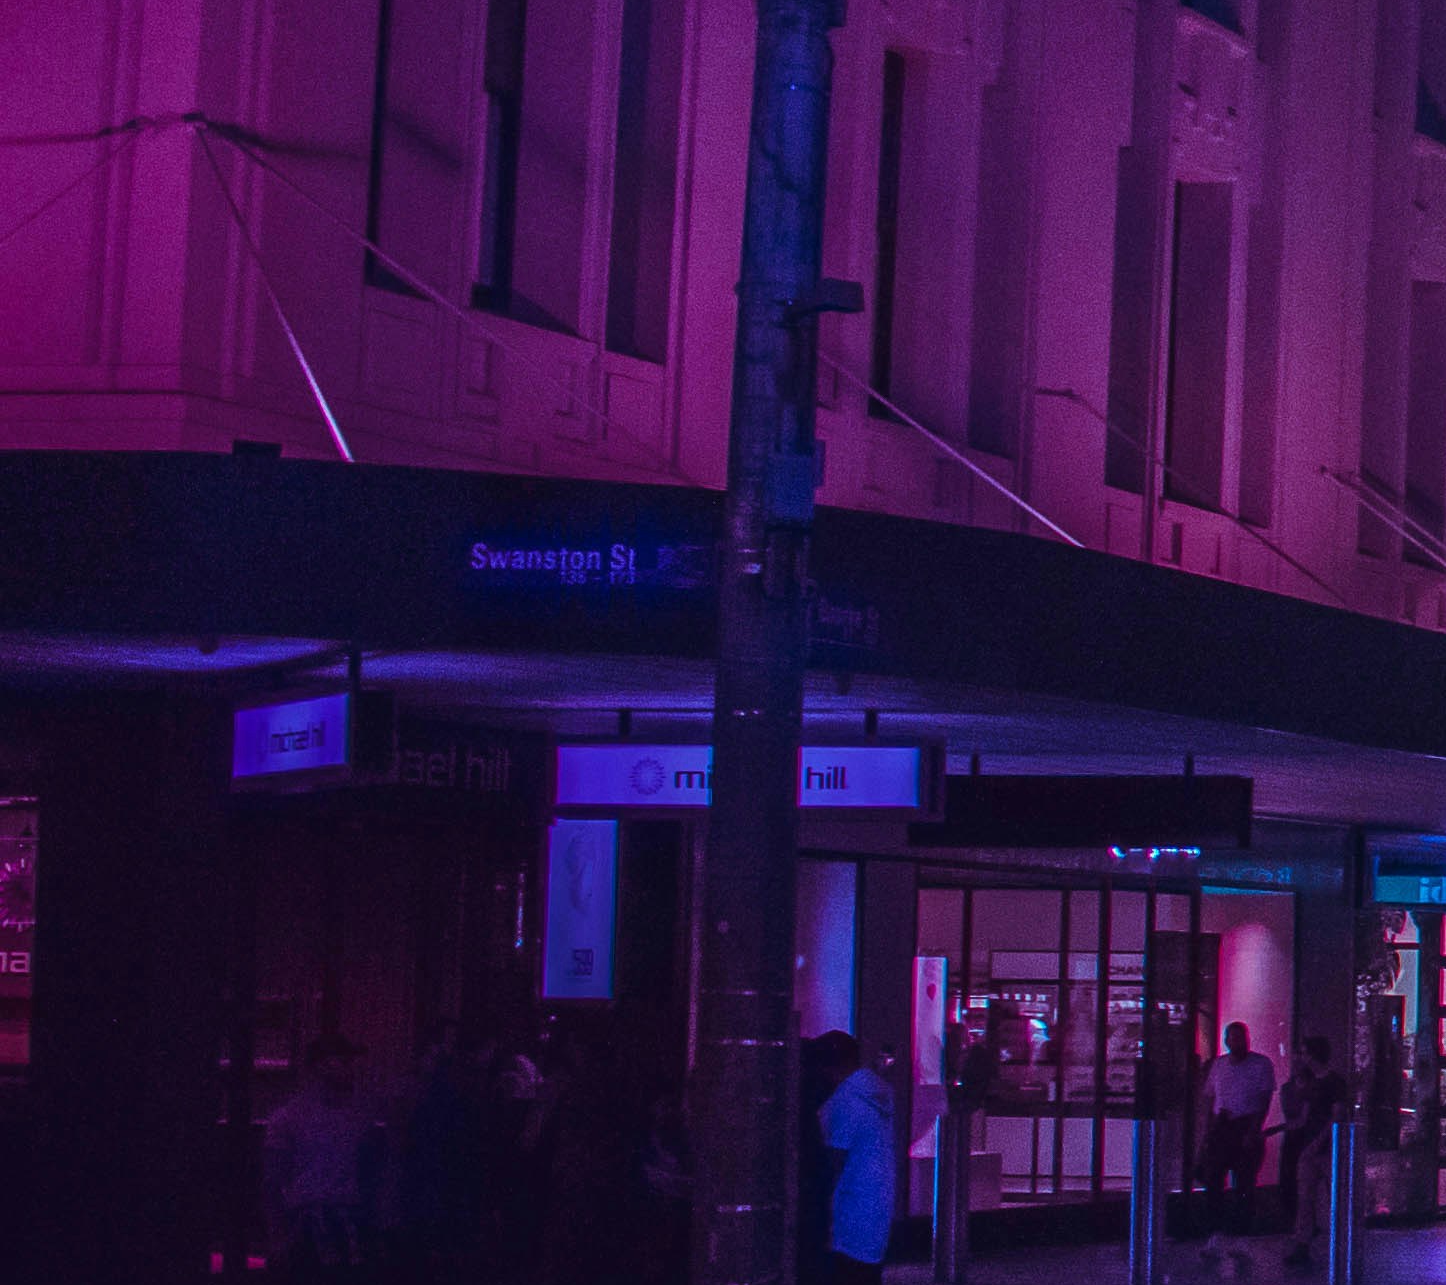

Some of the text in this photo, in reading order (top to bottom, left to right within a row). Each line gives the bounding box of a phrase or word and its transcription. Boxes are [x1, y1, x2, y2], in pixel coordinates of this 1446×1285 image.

[471, 543, 637, 571] Swanston St
[804, 766, 846, 790] hill
